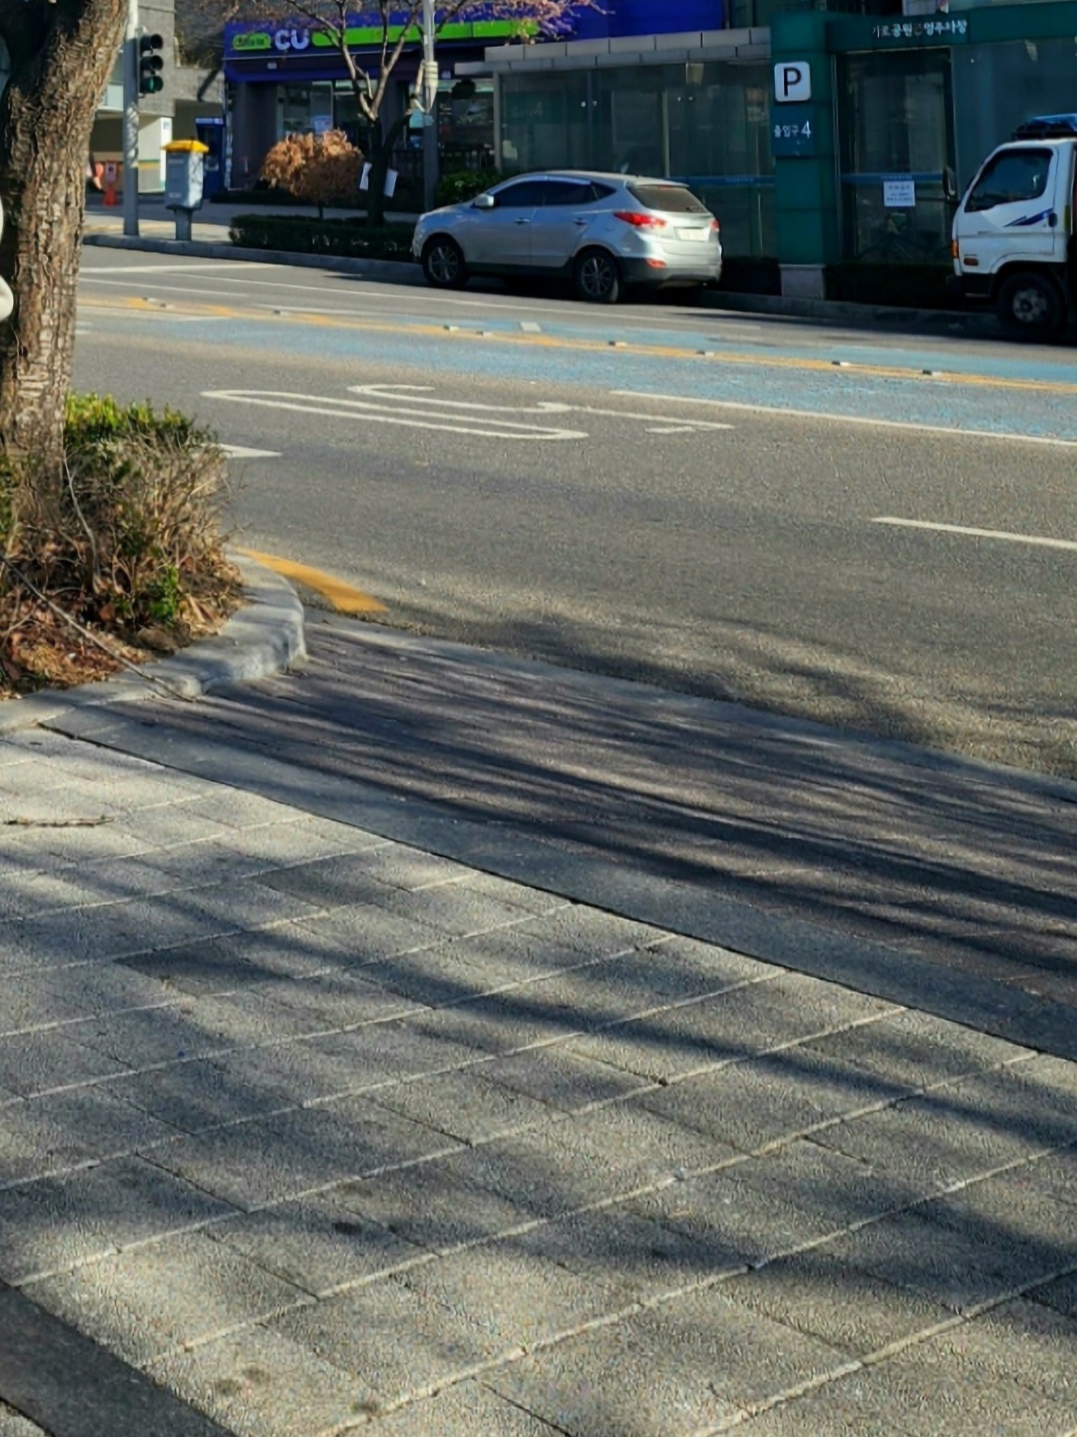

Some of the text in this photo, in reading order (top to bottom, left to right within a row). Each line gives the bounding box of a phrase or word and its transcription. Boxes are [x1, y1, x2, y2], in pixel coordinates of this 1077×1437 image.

[275, 28, 310, 51] CU
[783, 67, 802, 97] P
[801, 120, 812, 139] 4
